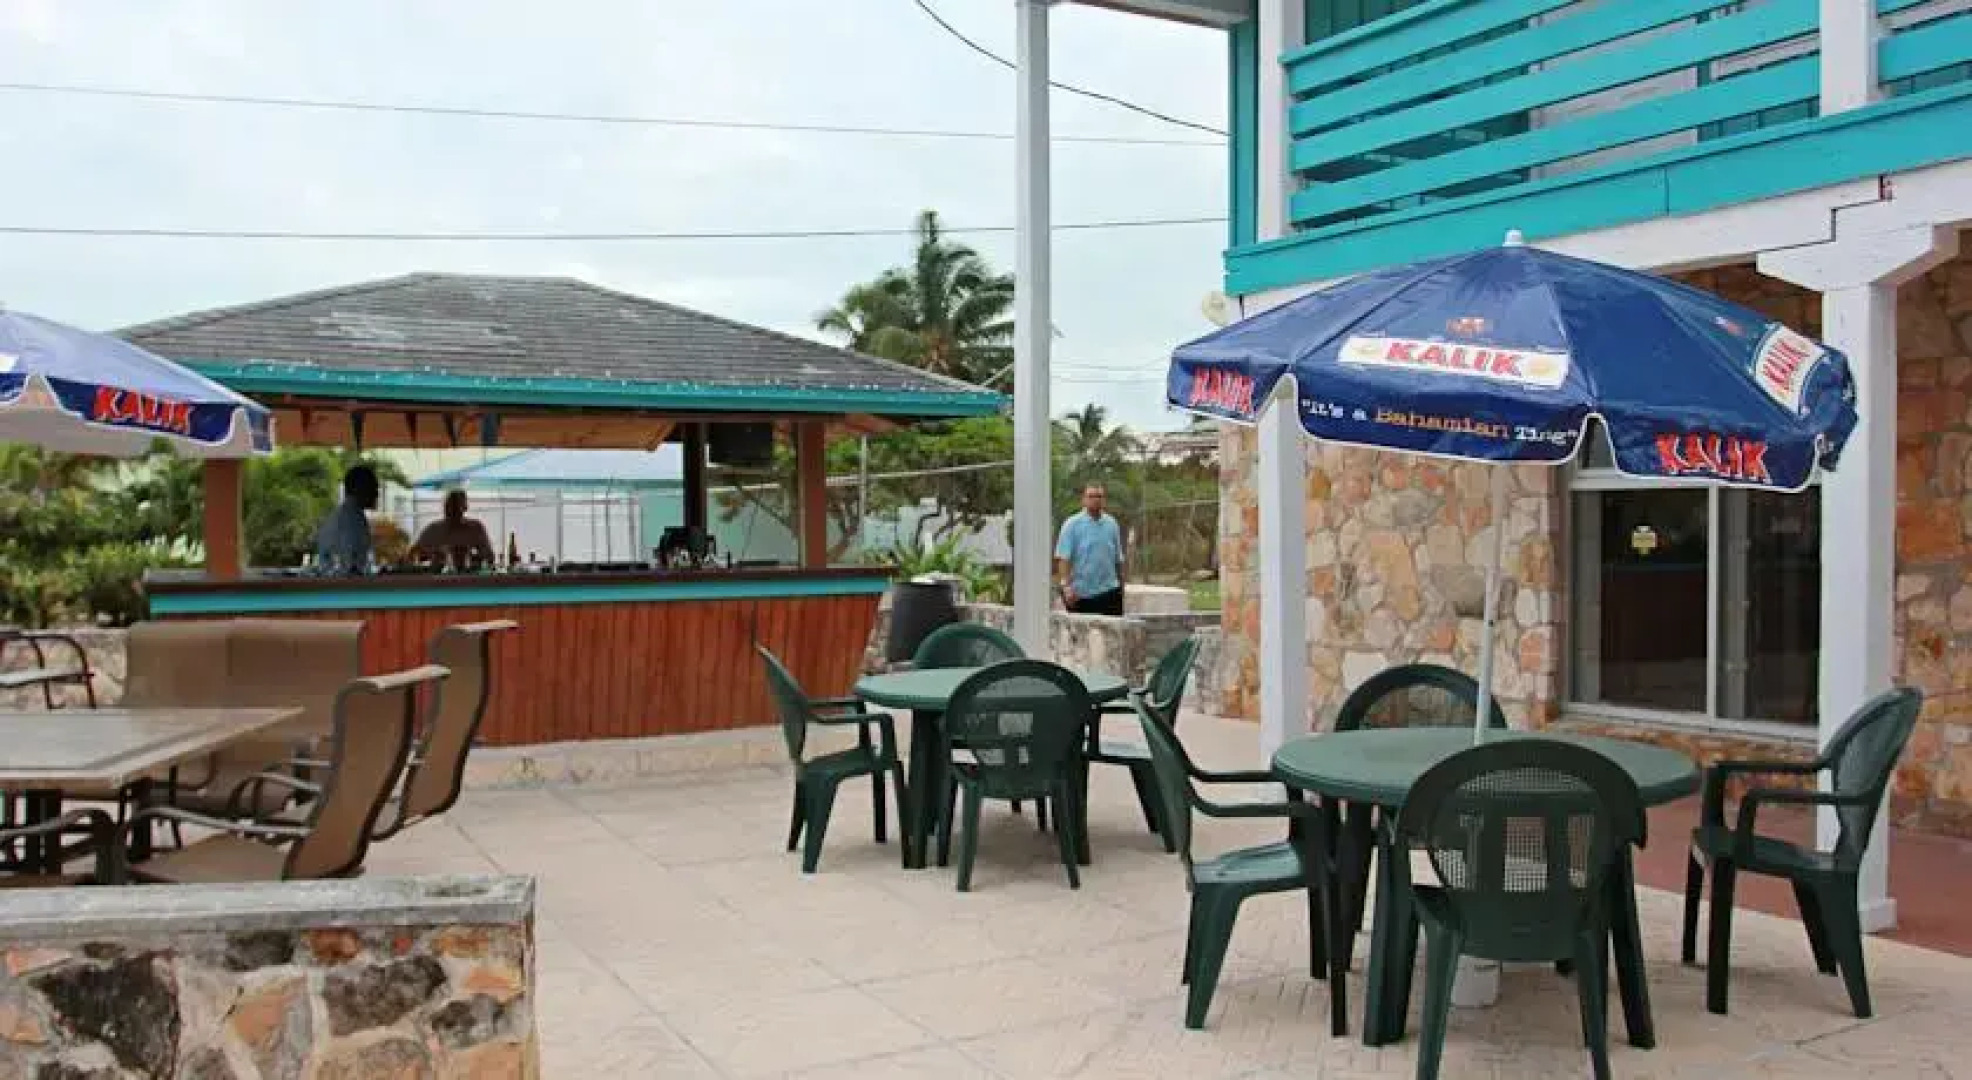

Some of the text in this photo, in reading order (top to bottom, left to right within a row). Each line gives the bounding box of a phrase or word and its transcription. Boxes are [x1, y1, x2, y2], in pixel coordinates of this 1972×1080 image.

[1386, 342, 1522, 376] KALIK
[1763, 340, 1810, 390] KALIK
[94, 384, 195, 434] KALIK
[1190, 365, 1254, 416] KALIK
[1375, 406, 1509, 438] Bahamian
[1656, 433, 1772, 483] KALIK
